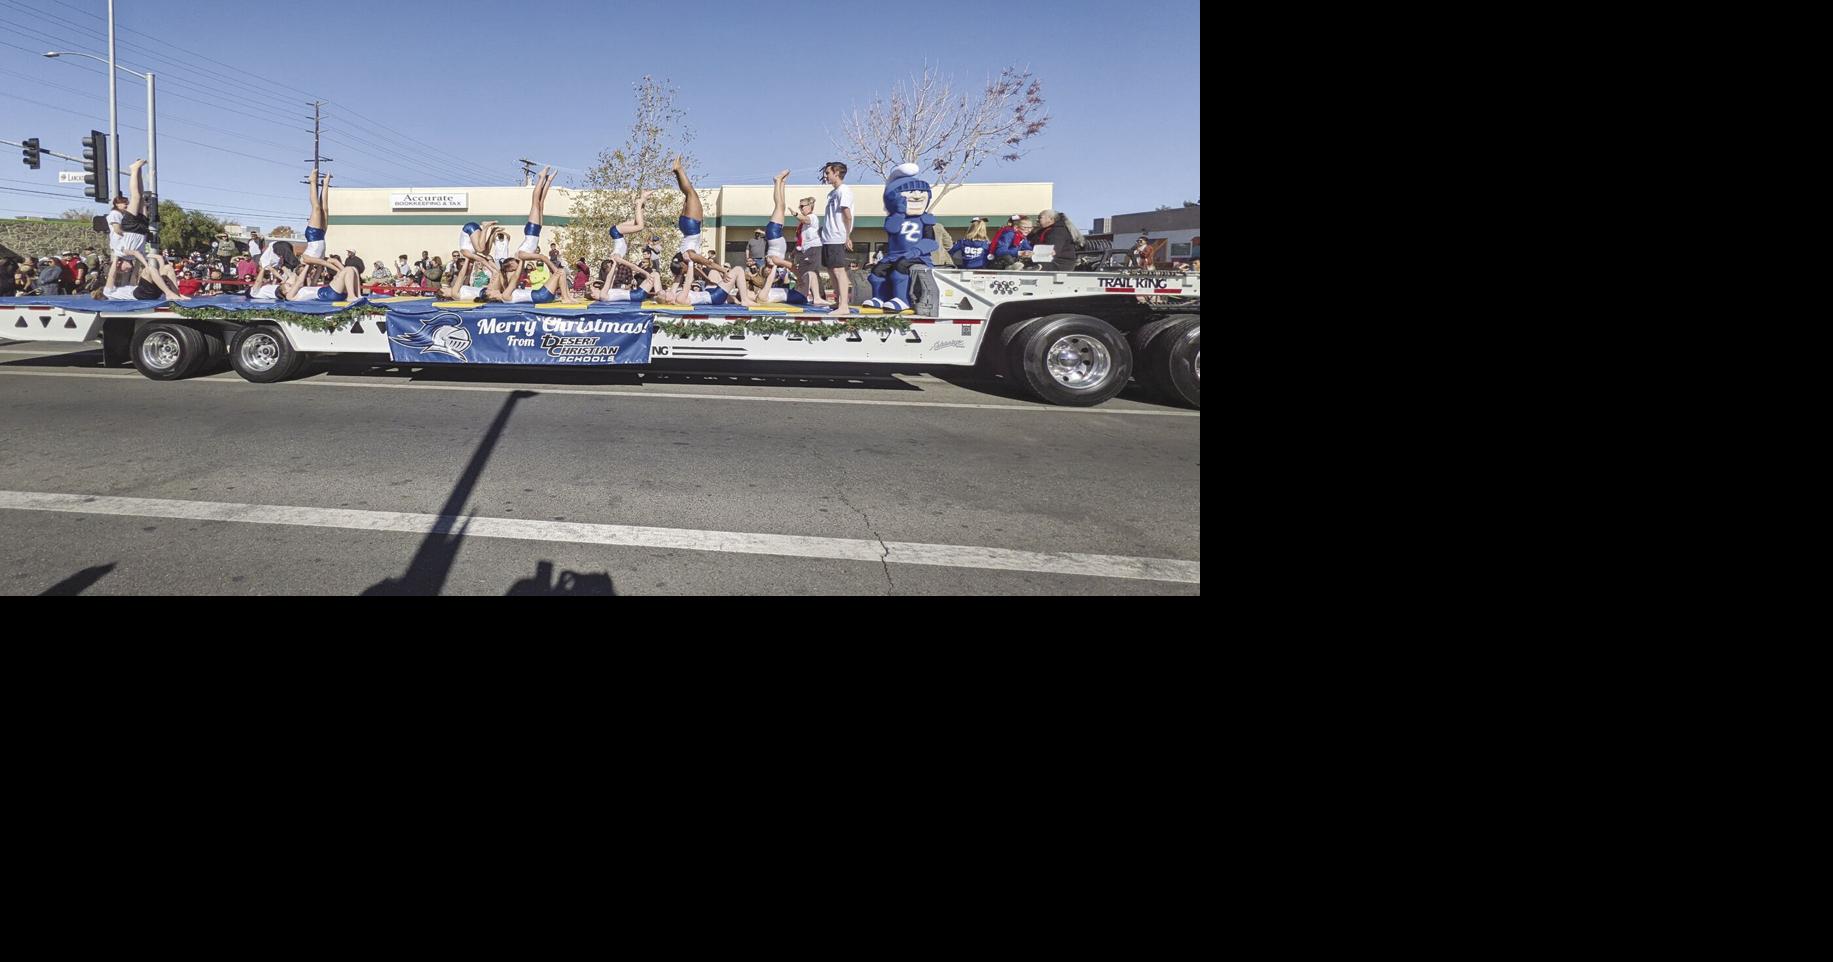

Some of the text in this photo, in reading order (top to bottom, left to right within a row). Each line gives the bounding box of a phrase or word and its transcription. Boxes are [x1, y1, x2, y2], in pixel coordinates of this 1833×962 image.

[1097, 277, 1168, 289] TRAIL KING
[477, 316, 649, 336] Merry Christmas!
[507, 335, 535, 347] From
[541, 333, 600, 349] DESERT
[547, 346, 619, 357] CHRISTIAN
[652, 345, 669, 356] NG
